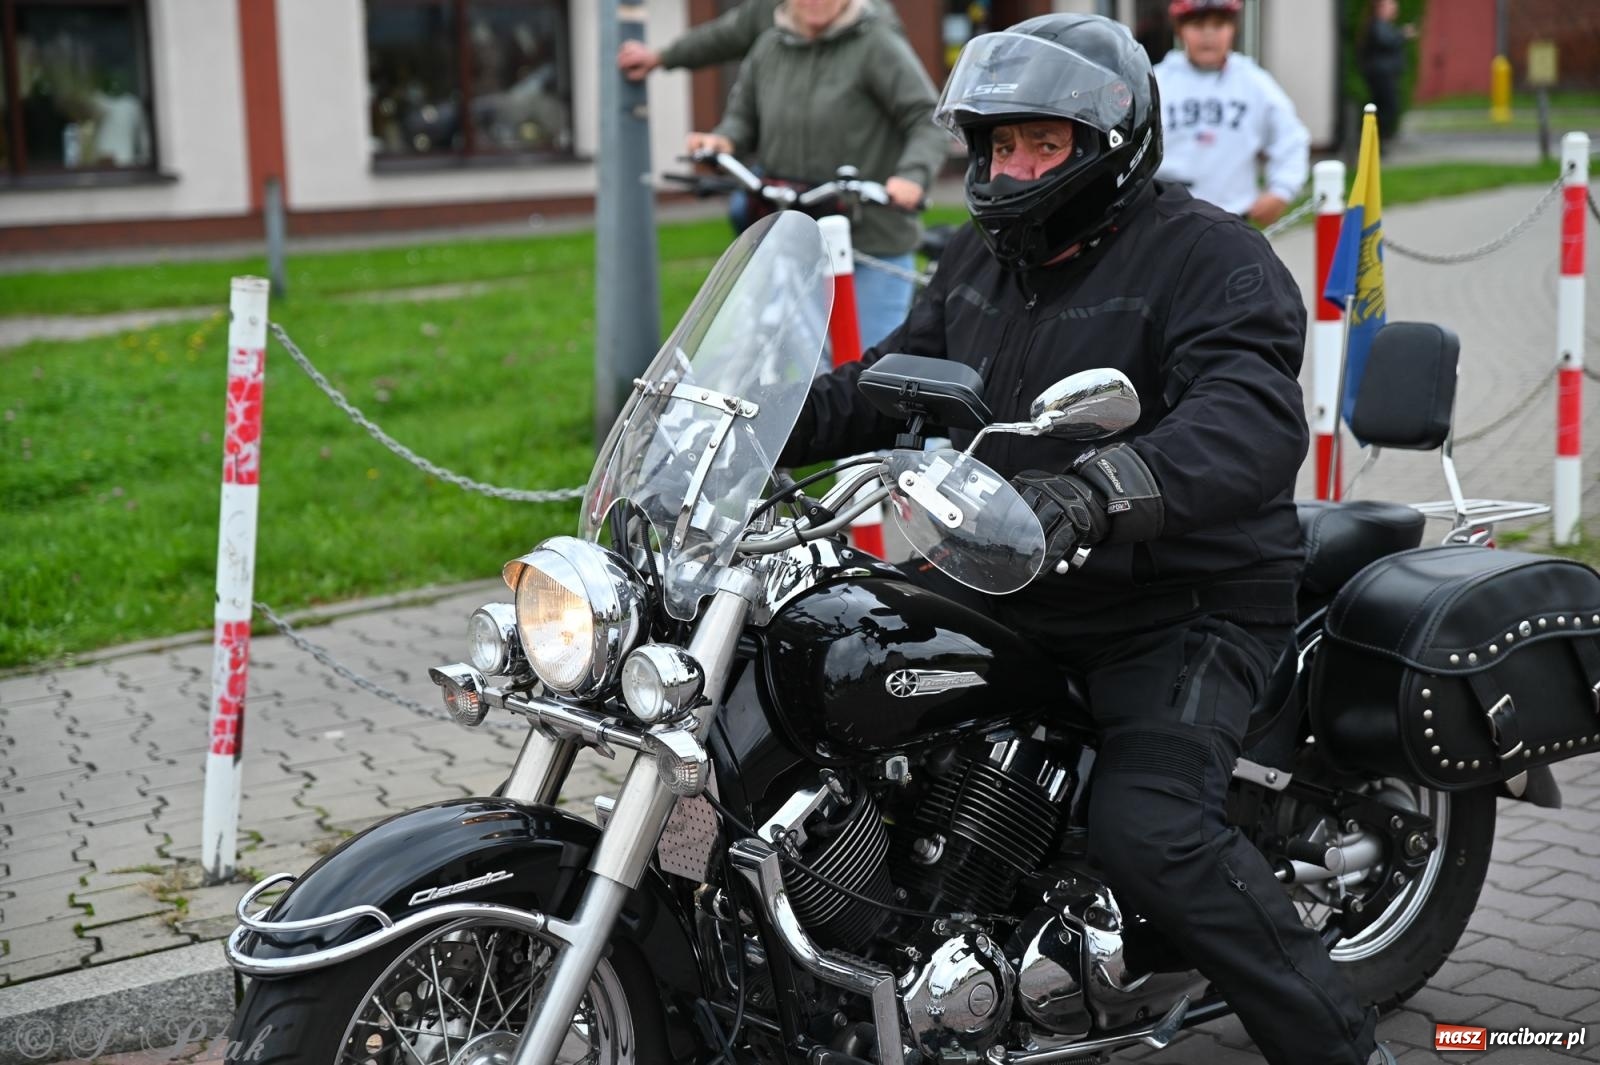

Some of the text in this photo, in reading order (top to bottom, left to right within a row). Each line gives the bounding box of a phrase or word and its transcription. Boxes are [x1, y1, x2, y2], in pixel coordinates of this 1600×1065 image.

[961, 83, 1019, 100] LS2
[1166, 98, 1248, 130] 1997
[1116, 127, 1153, 188] LS2
